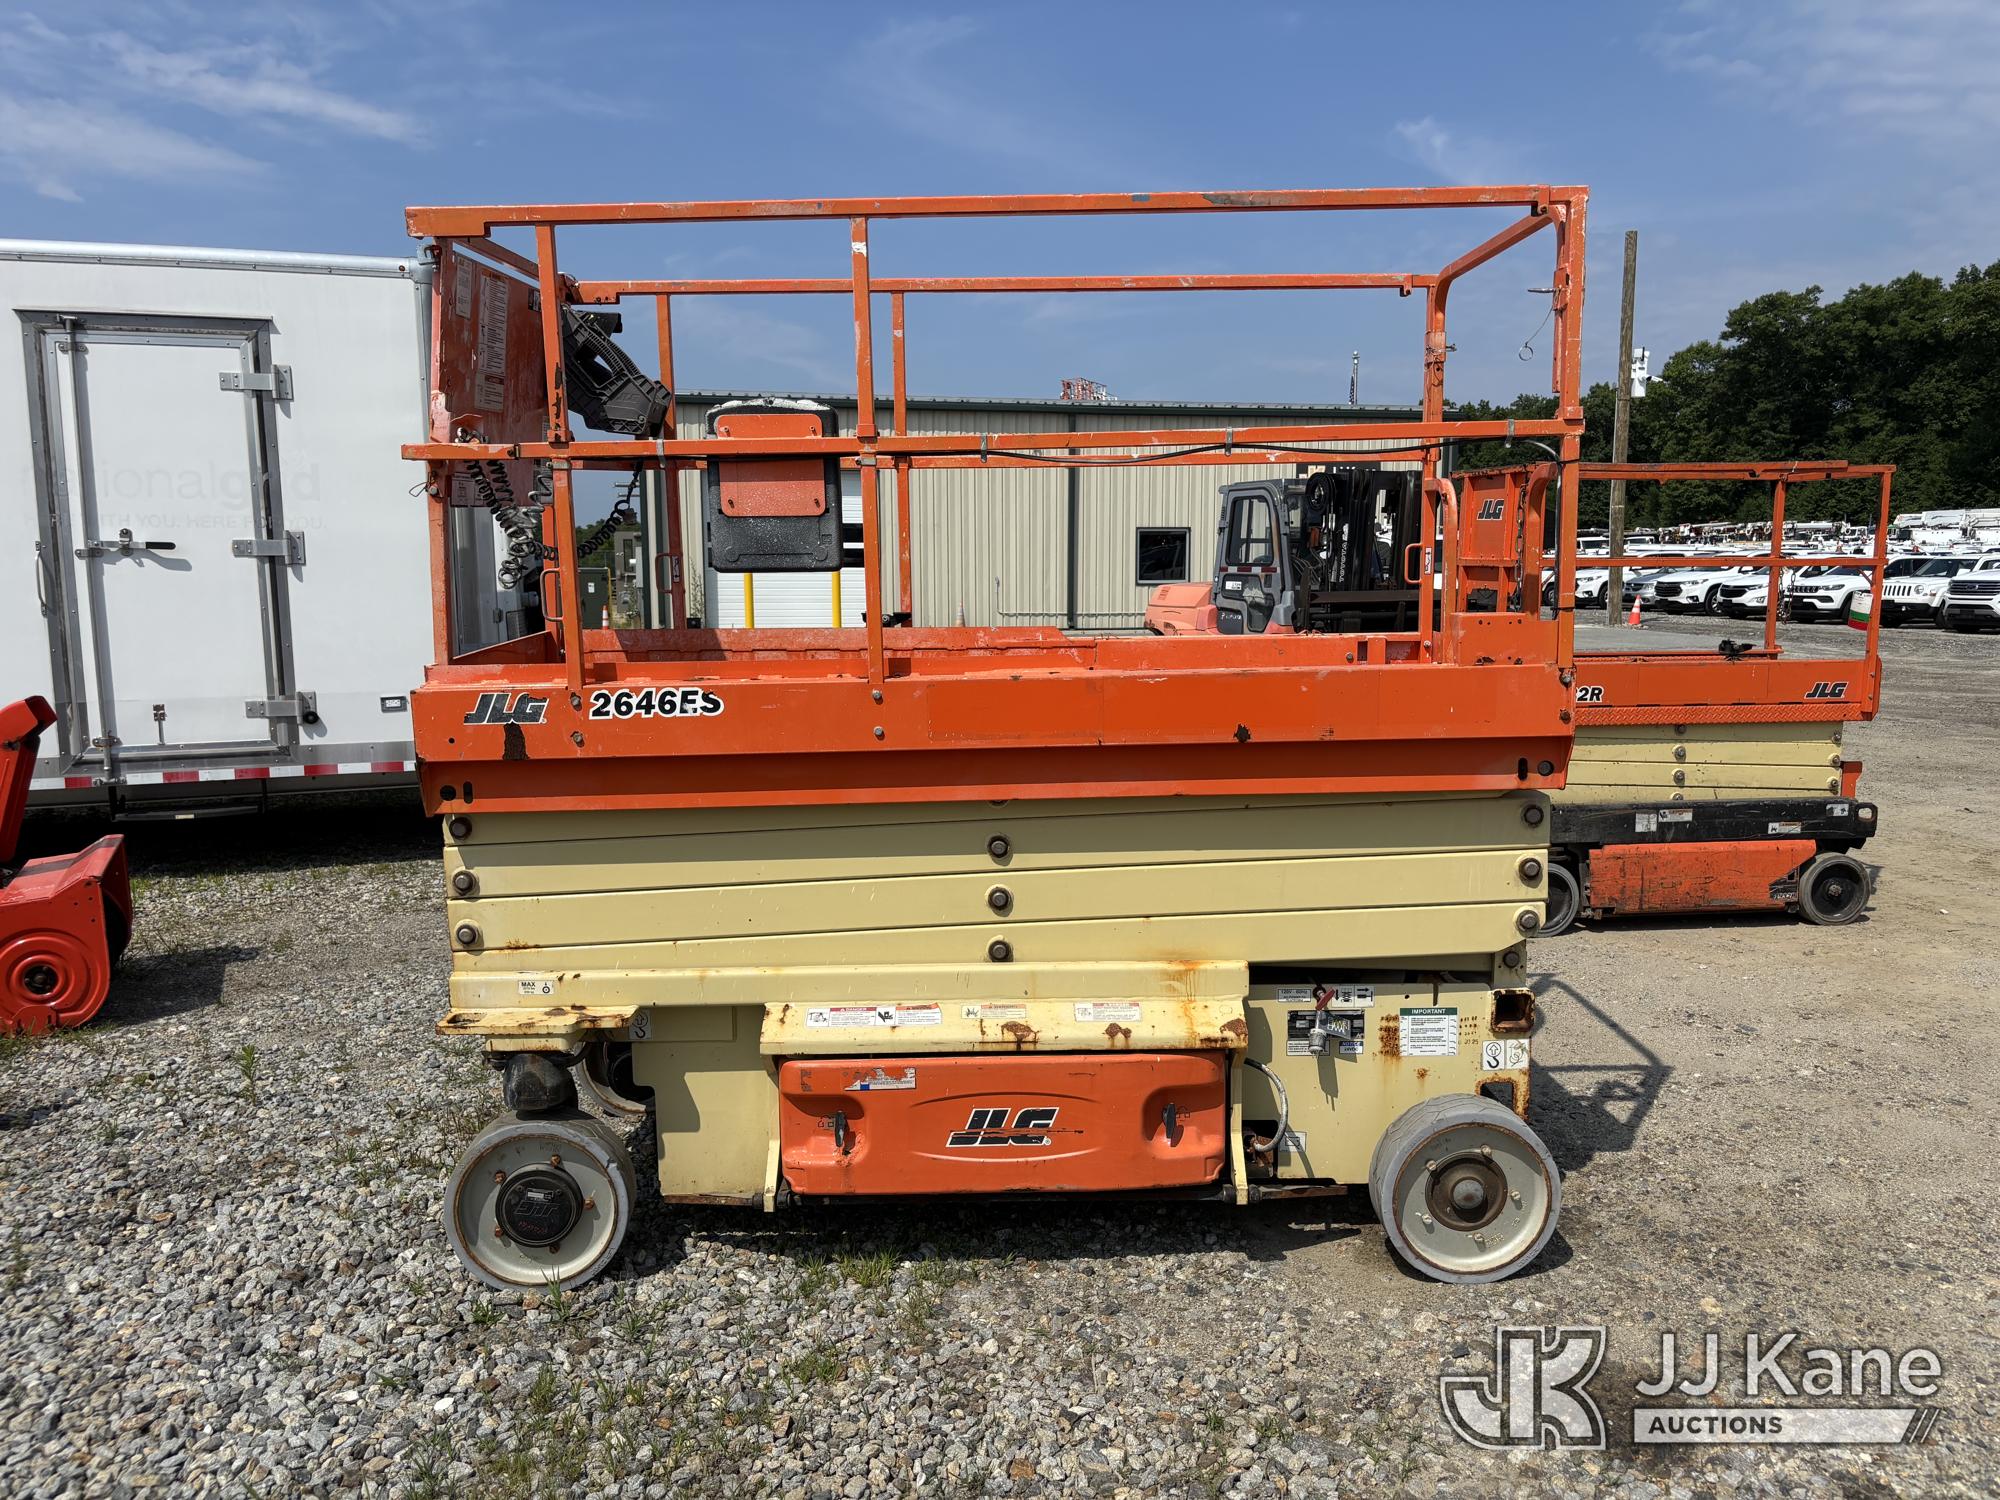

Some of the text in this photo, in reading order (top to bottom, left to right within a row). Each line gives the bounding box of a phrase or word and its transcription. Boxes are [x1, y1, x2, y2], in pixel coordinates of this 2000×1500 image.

[1477, 499, 1505, 520] JLG
[1576, 686, 1604, 702] 2R
[1804, 682, 1848, 699] JLG
[464, 688, 724, 725] JLG 2646ES
[946, 1107, 1059, 1147] JLG
